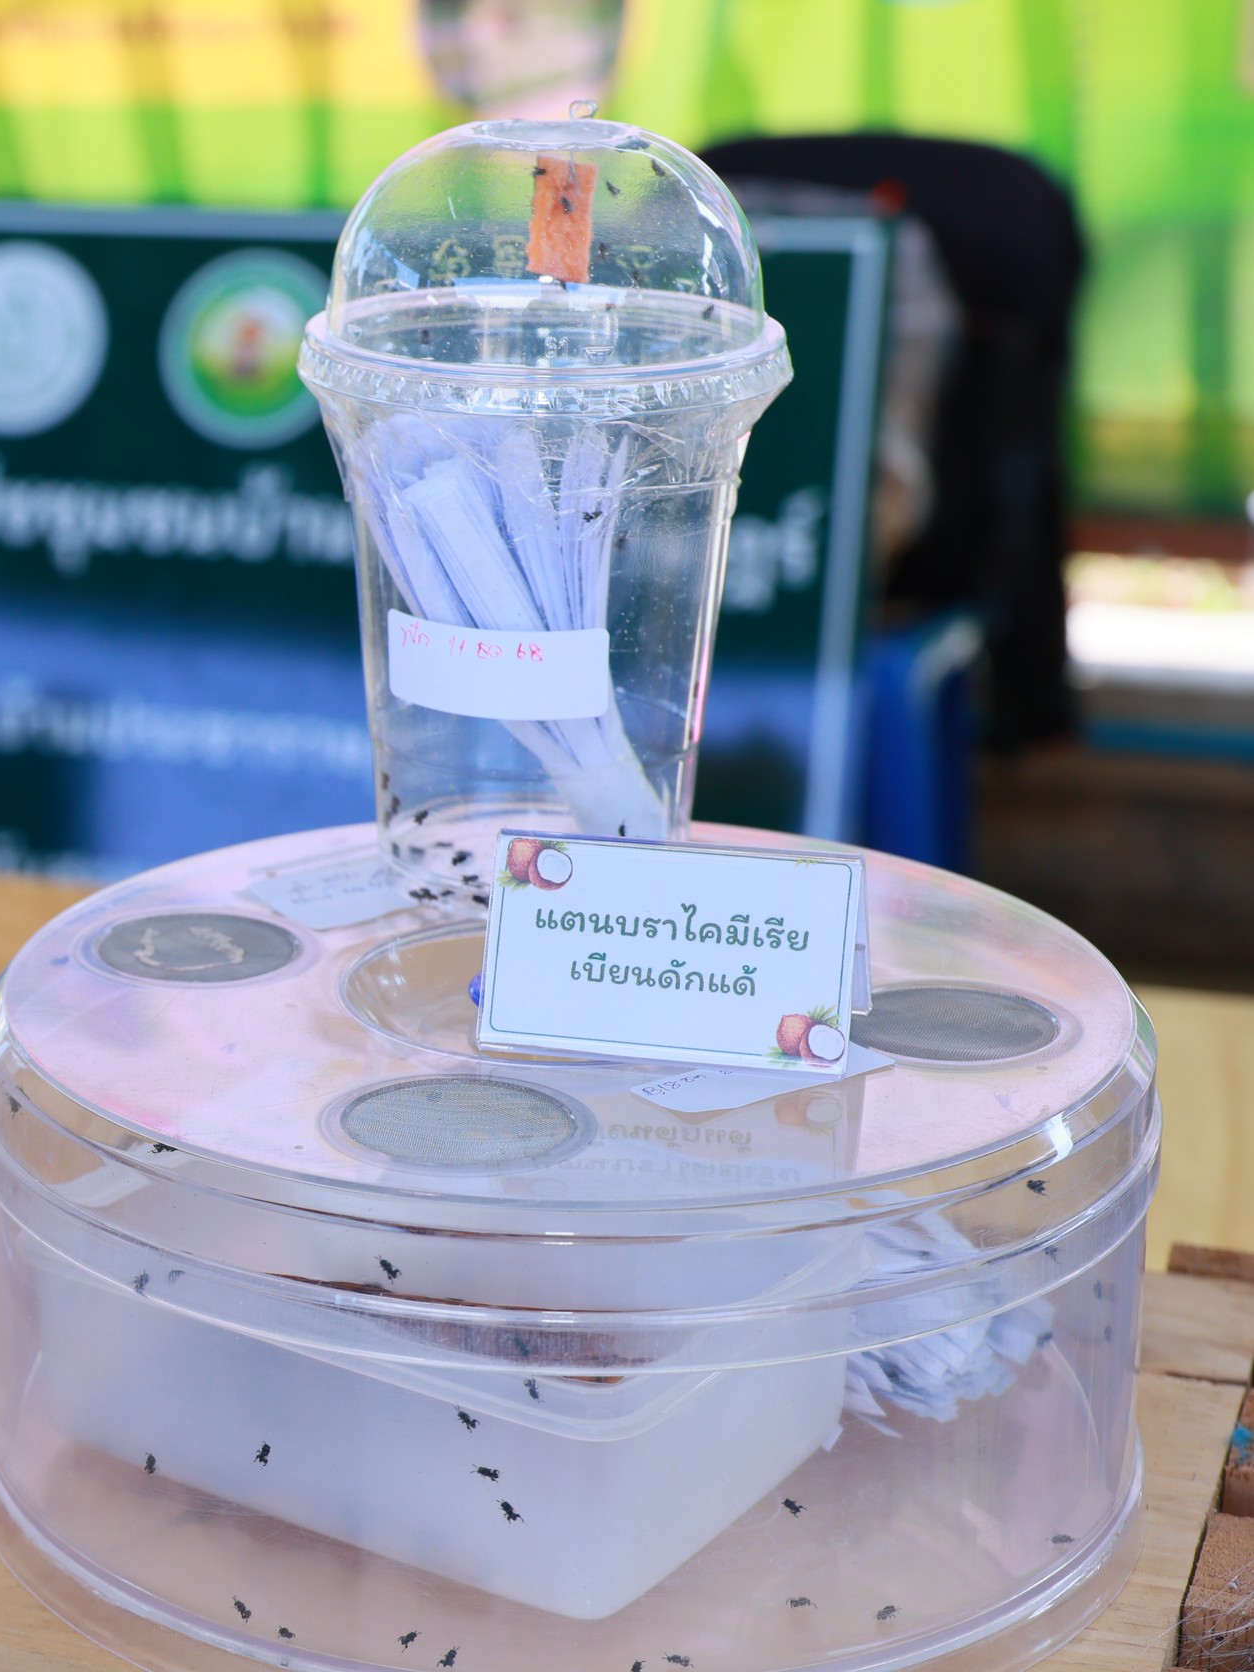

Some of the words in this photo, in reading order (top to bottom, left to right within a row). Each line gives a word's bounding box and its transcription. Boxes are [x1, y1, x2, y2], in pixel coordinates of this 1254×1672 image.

[516, 642, 544, 662] 68
[534, 903, 810, 952] แตนบราไคมีเรีย
[570, 953, 758, 997] เบียนดักแด้
